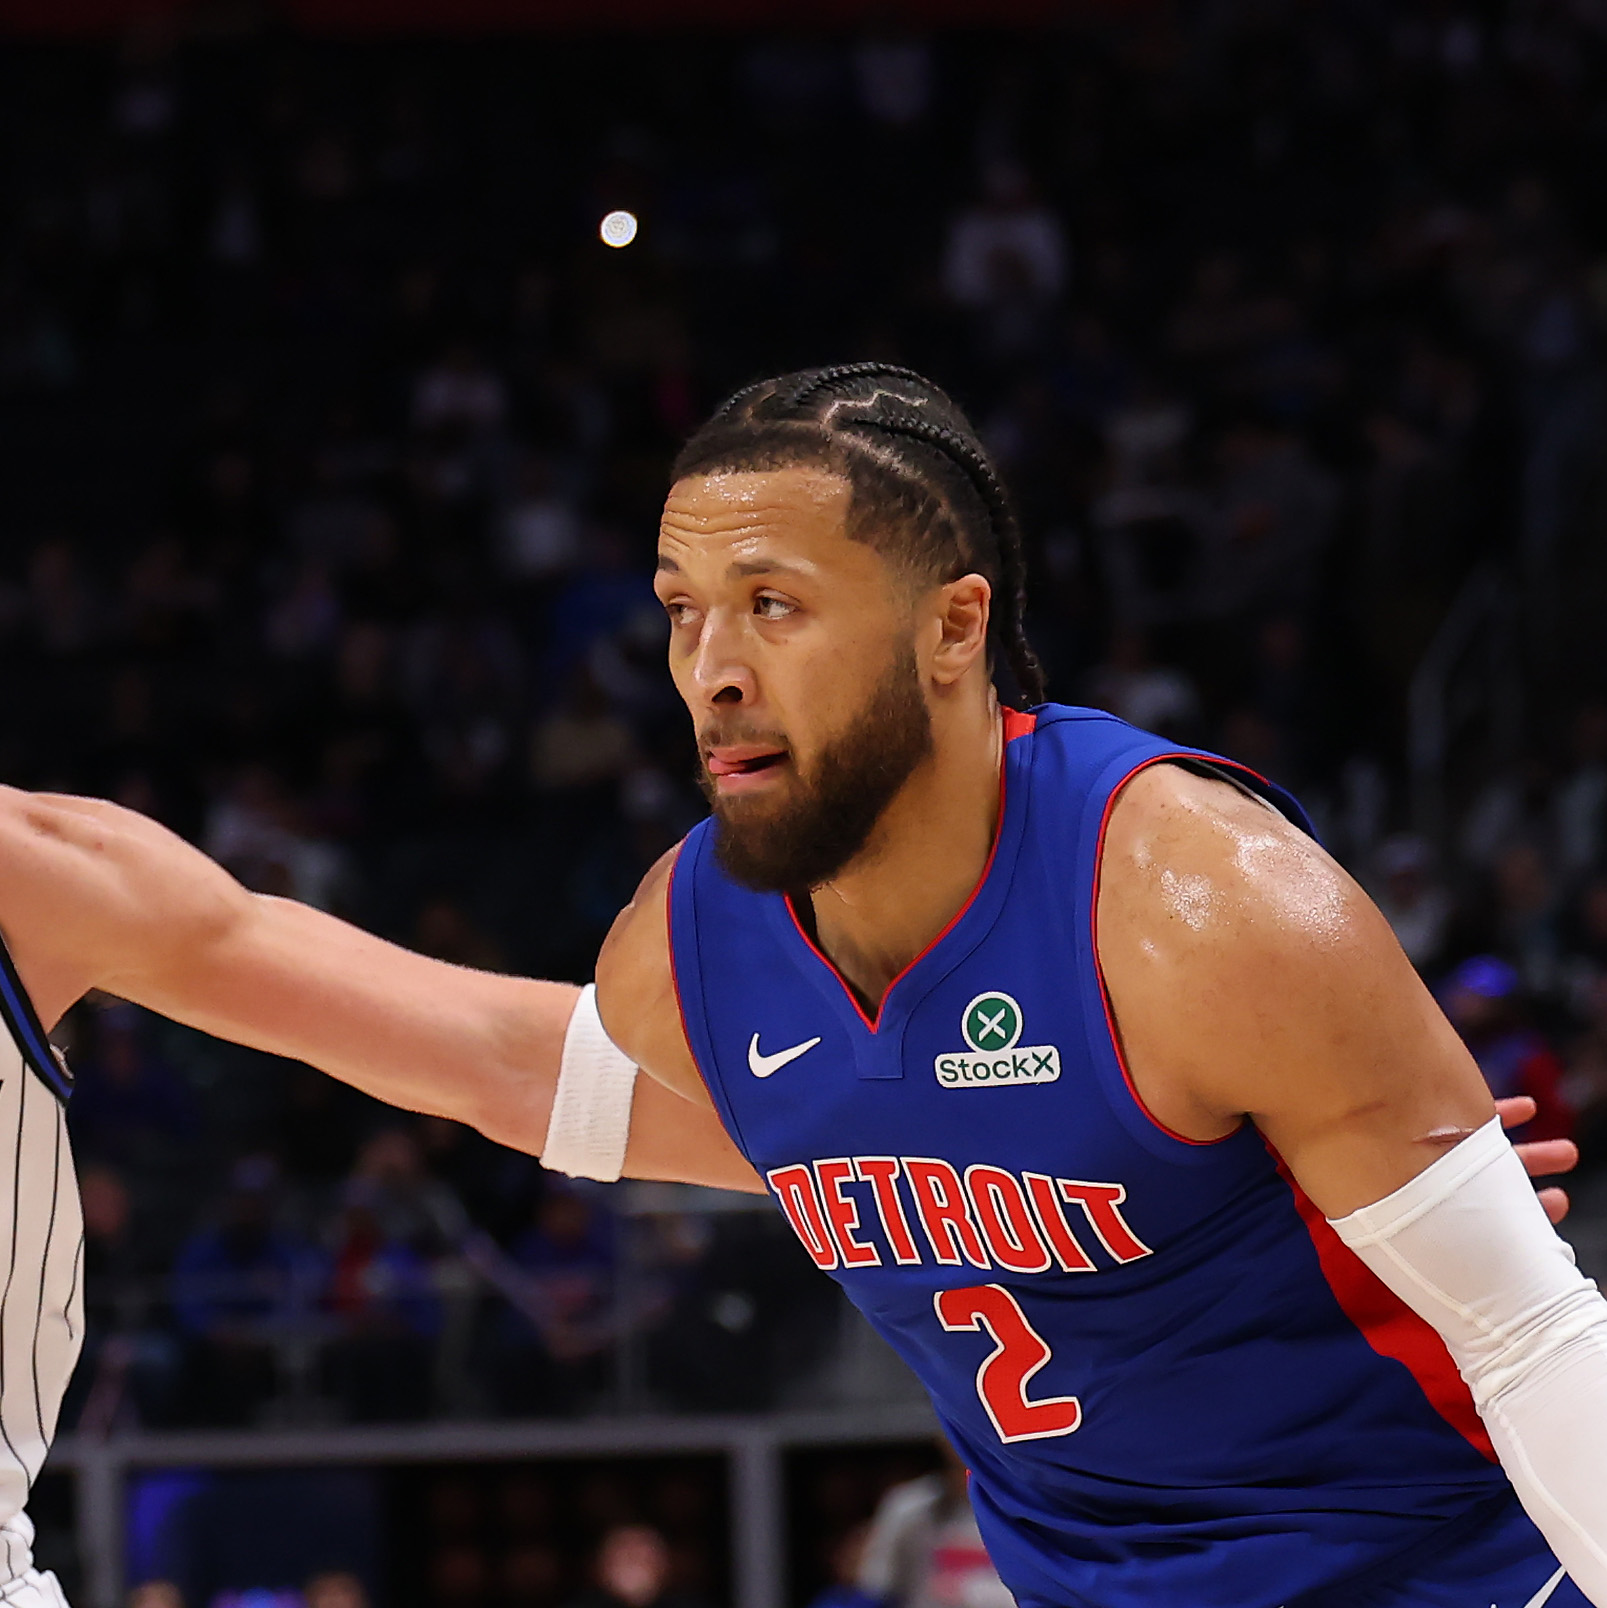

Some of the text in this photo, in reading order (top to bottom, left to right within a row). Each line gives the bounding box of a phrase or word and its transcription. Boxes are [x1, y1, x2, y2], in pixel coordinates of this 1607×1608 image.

[939, 1051, 1054, 1083] StockX
[766, 1156, 1154, 1274] DETROIT
[934, 1284, 1082, 1444] 2
